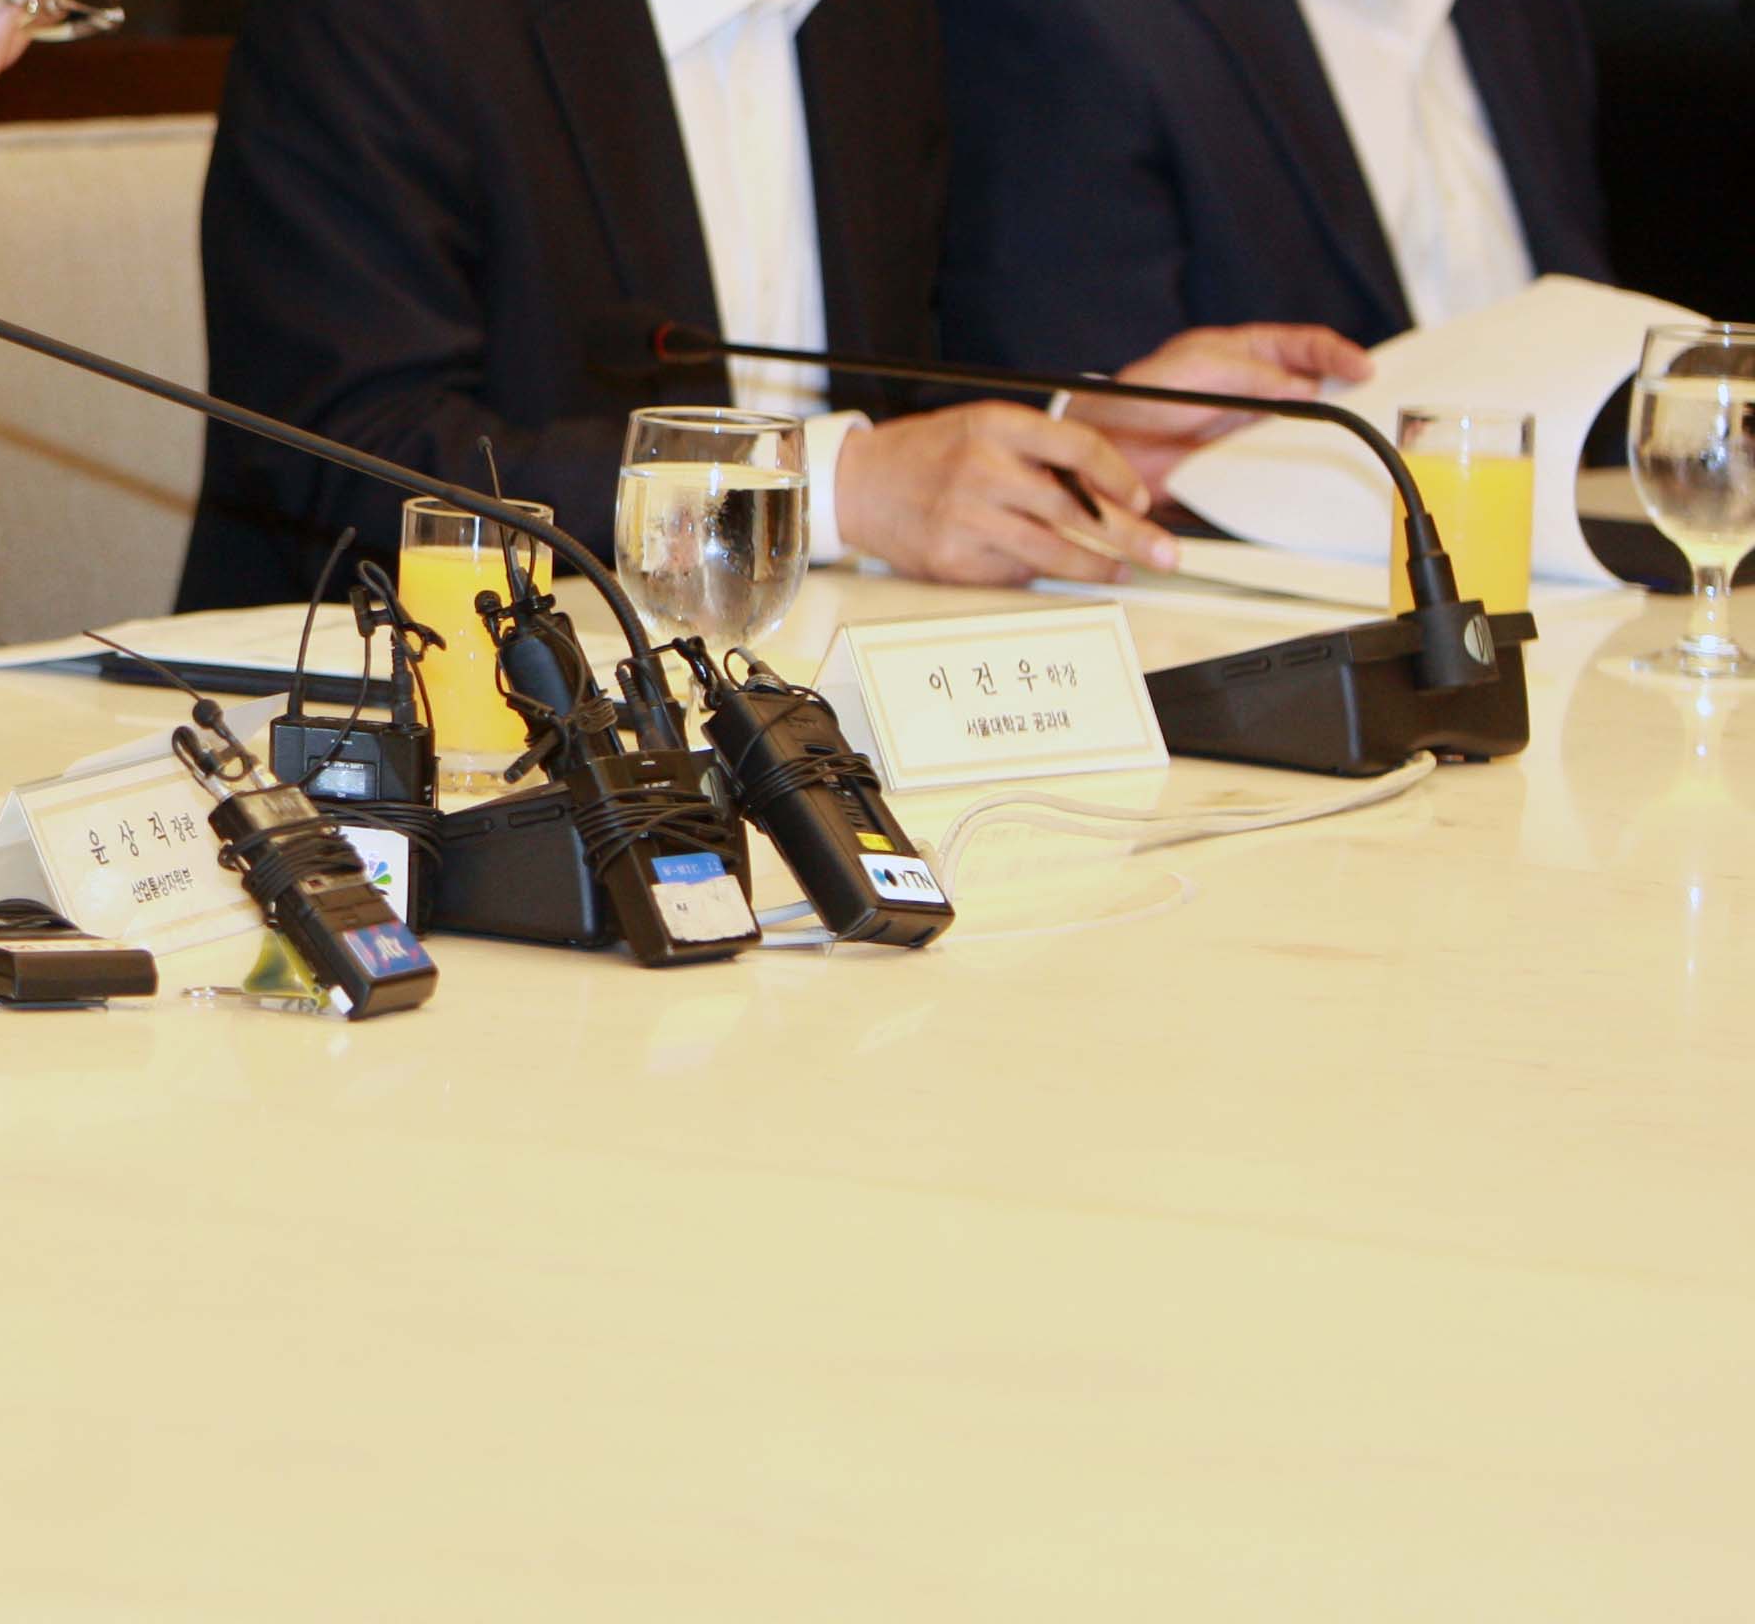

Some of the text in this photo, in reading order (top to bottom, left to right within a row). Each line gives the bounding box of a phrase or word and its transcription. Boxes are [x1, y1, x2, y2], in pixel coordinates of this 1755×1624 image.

[966, 710, 1071, 738] 서울대학교 공과대
[132, 868, 194, 903] 산업통상자원부
[899, 869, 936, 890] YTN
